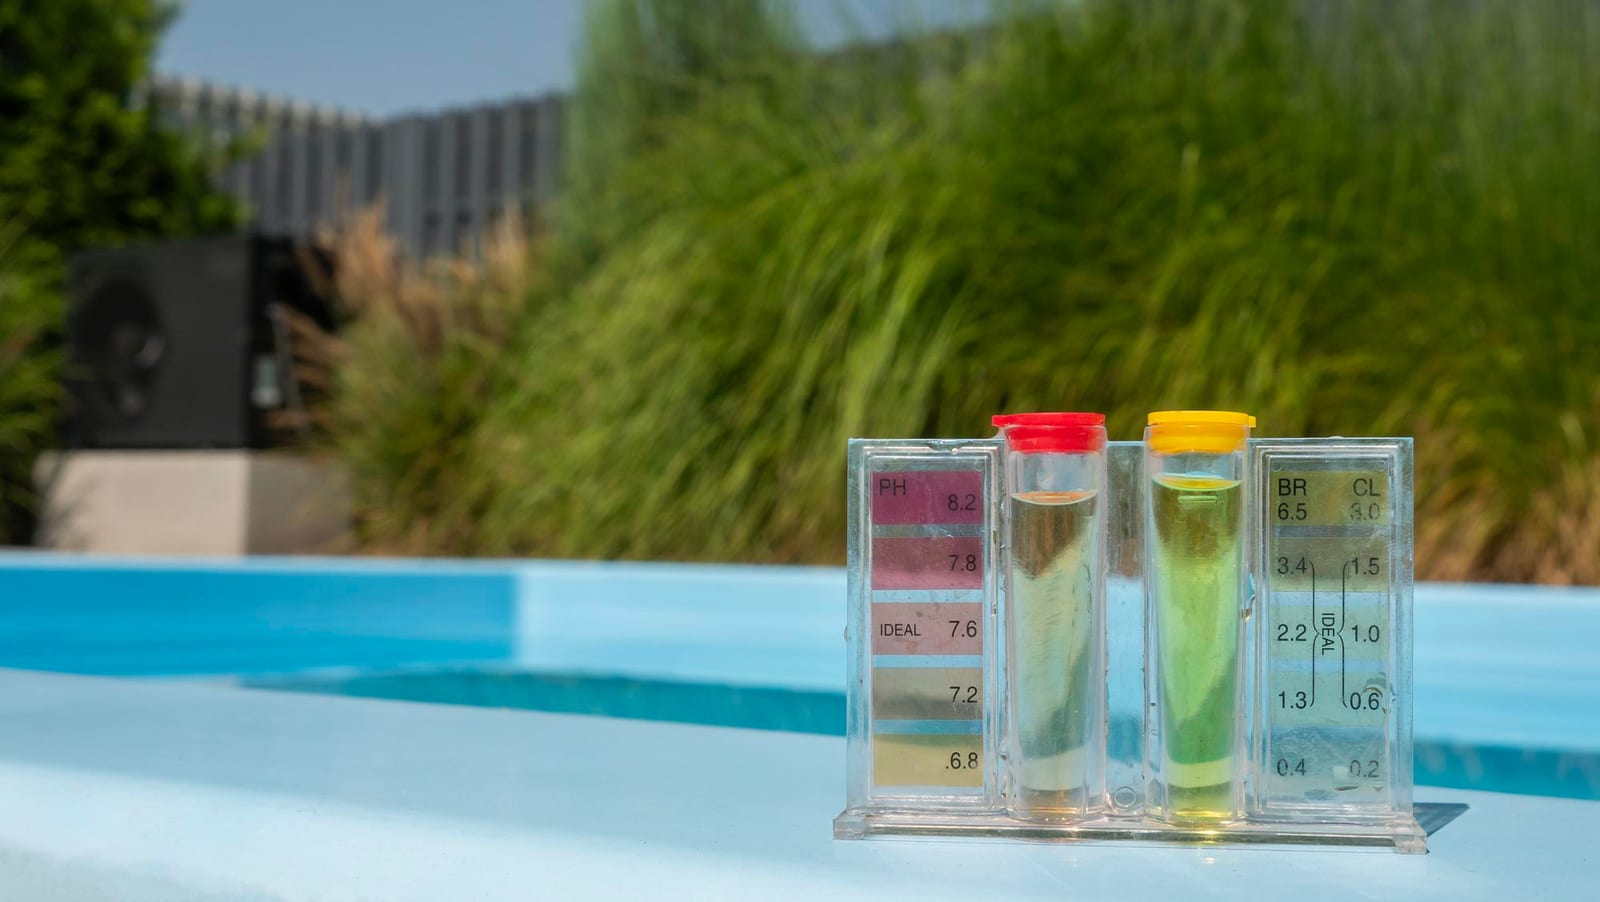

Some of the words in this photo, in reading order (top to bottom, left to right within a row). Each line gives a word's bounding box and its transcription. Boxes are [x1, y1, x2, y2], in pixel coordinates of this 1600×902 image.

[879, 479, 906, 496] PH
[1278, 478, 1307, 496] BR
[1352, 478, 1381, 496] CL
[947, 493, 976, 511] 8.2
[1277, 502, 1307, 520] 6.5
[949, 554, 977, 572] 7.8
[1277, 557, 1307, 575] 3.4
[1351, 557, 1380, 575] 1.5
[880, 623, 921, 637] IDEAL
[948, 620, 977, 638] 7.6
[1277, 624, 1307, 642] 2.2
[1321, 613, 1335, 656] IDEAL
[1351, 624, 1380, 643] 1.0
[949, 686, 978, 703] 7.2
[1278, 691, 1307, 709] 1.3
[1350, 691, 1380, 711] 0.6
[1276, 758, 1307, 776] 0.4
[1350, 759, 1380, 778] 0.2
